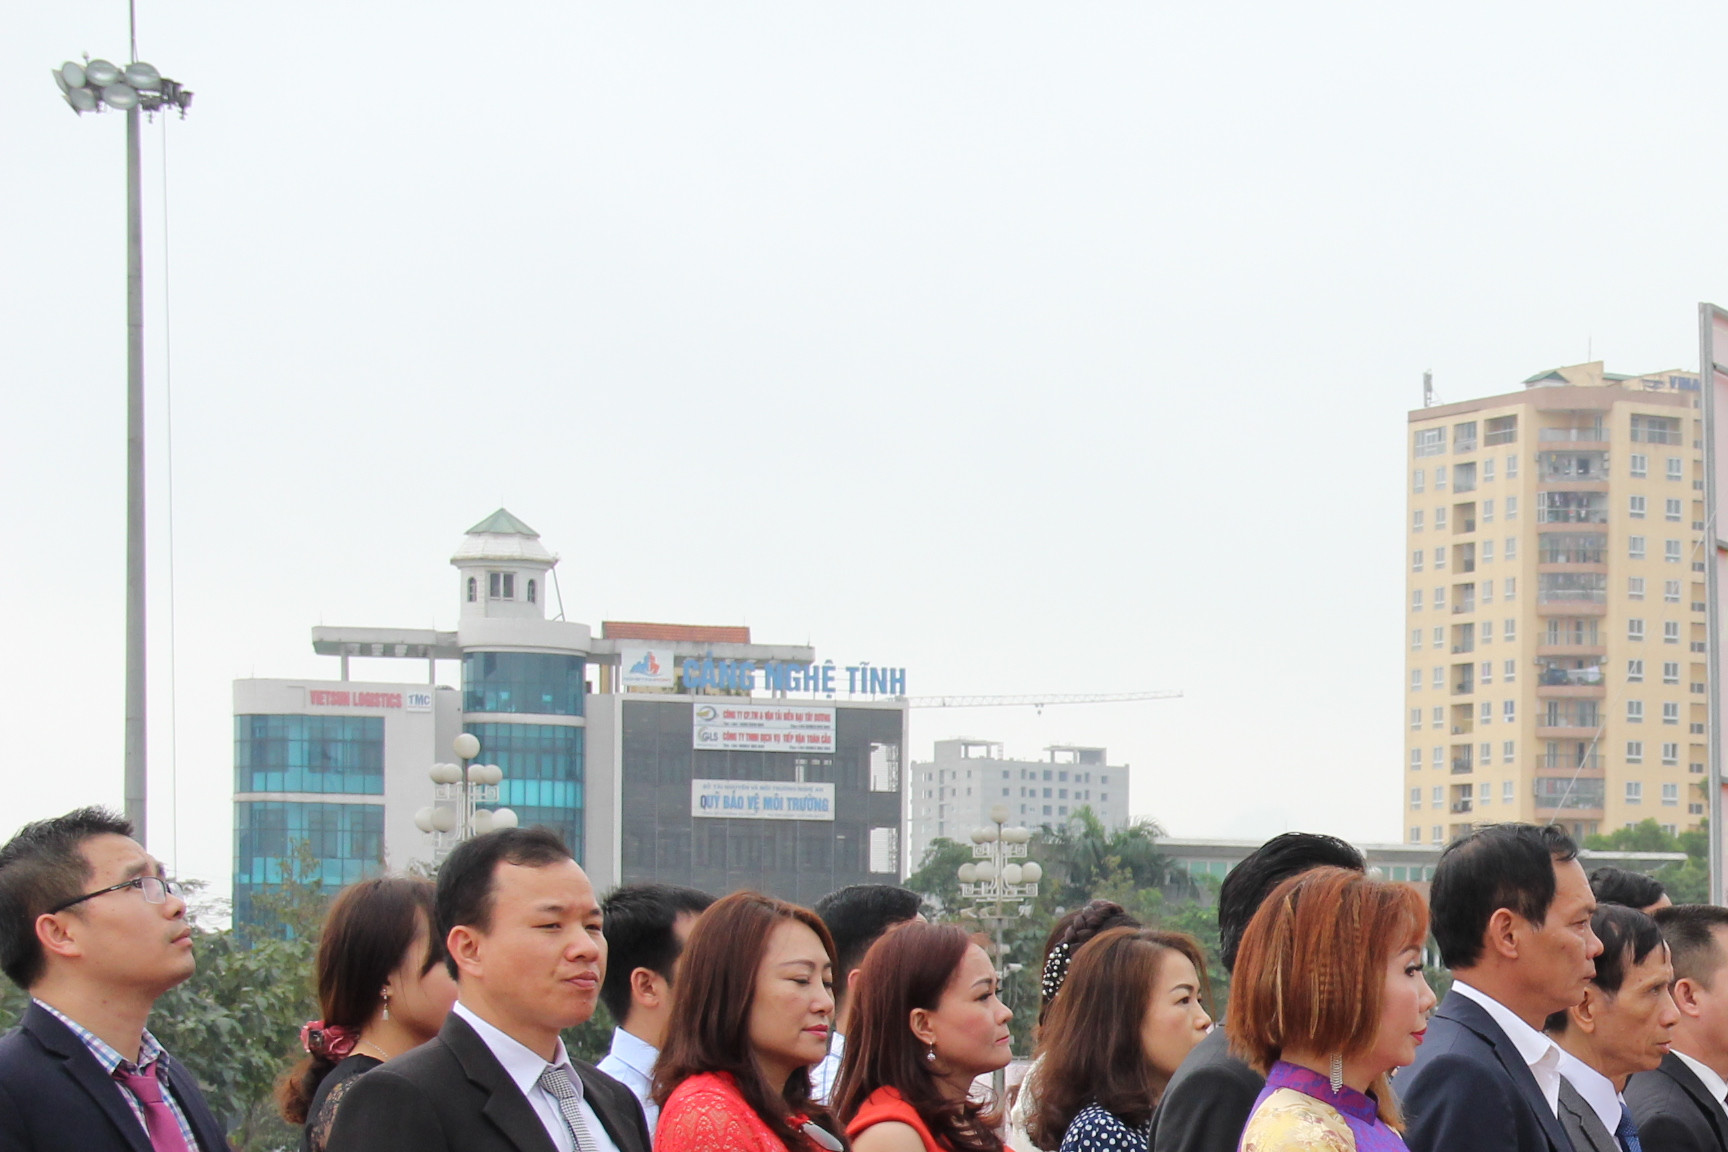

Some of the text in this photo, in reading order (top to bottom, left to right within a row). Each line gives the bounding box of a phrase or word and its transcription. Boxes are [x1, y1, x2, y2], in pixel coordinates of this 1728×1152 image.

[682, 650, 906, 698] CẢNG NGHỆ TĨNH
[353, 692, 402, 708] LOGISTICS
[408, 694, 430, 705] TMC
[747, 793, 760, 814] VỆ
[763, 793, 784, 811] MÔI
